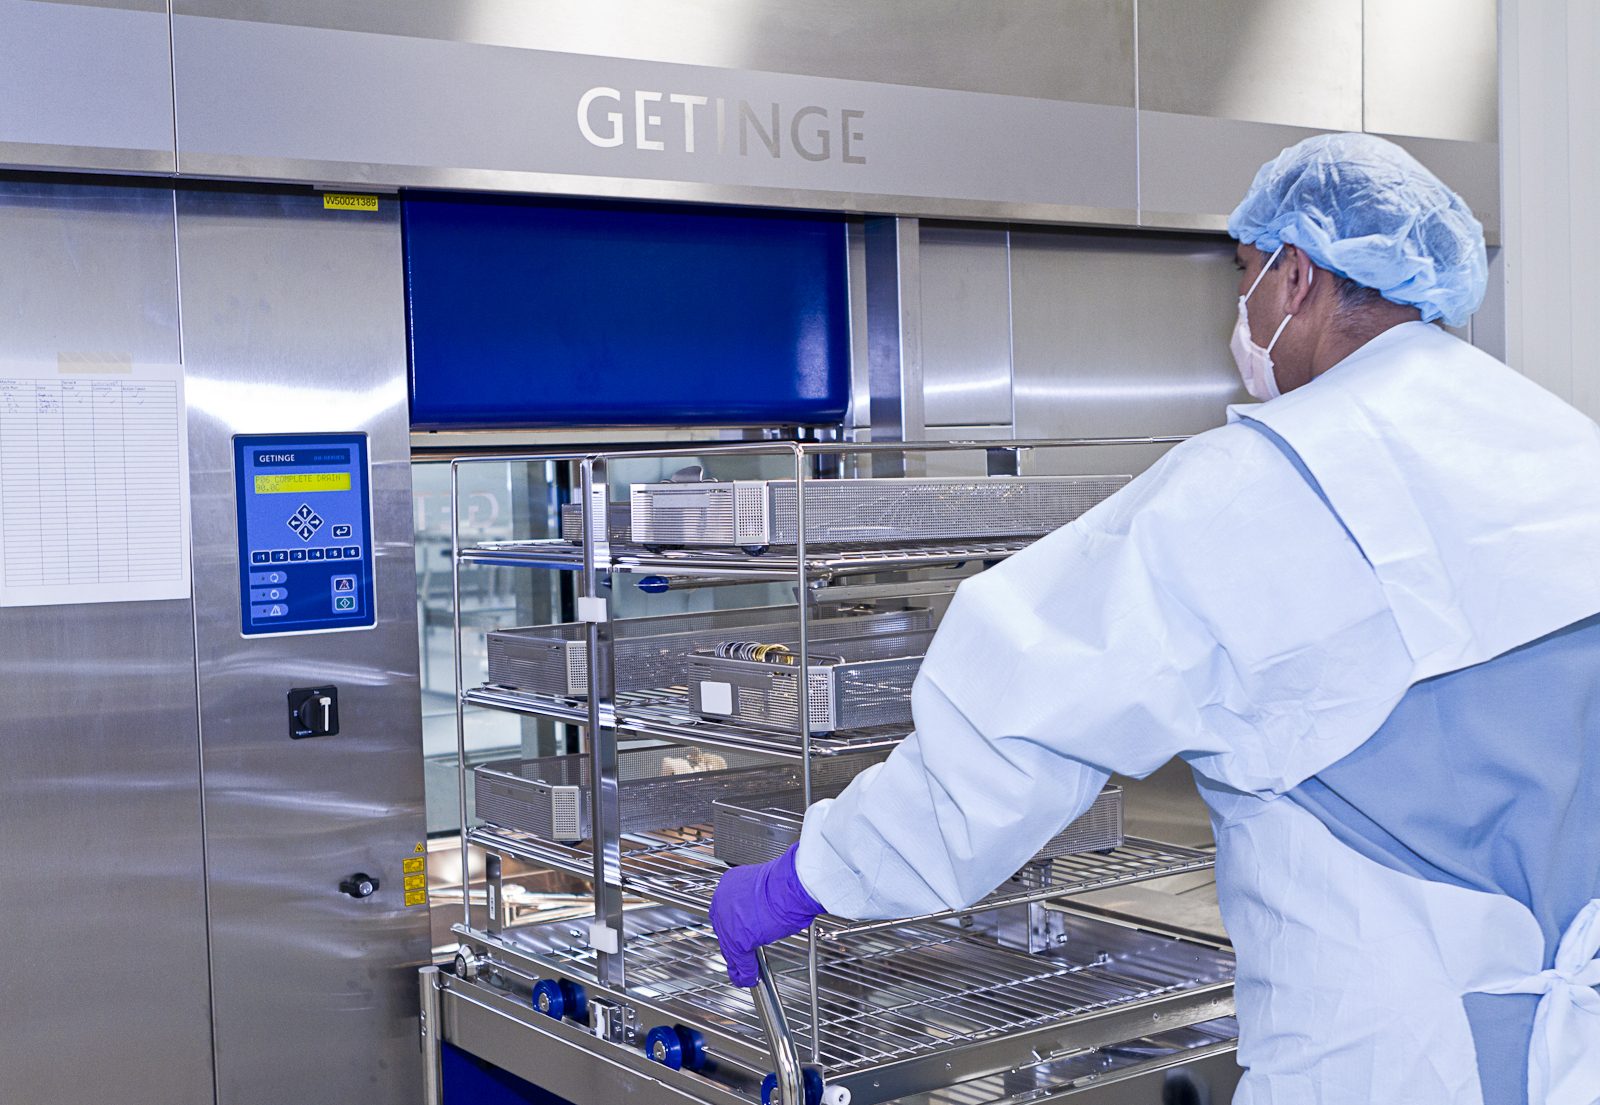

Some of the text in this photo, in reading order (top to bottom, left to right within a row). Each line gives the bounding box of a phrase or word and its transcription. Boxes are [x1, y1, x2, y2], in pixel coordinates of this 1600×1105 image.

[576, 86, 867, 165] GETINGE
[325, 196, 377, 207] W50021389
[259, 454, 295, 463] GETINGE
[274, 474, 313, 484] COMPLETE
[317, 473, 341, 483] DRAIN
